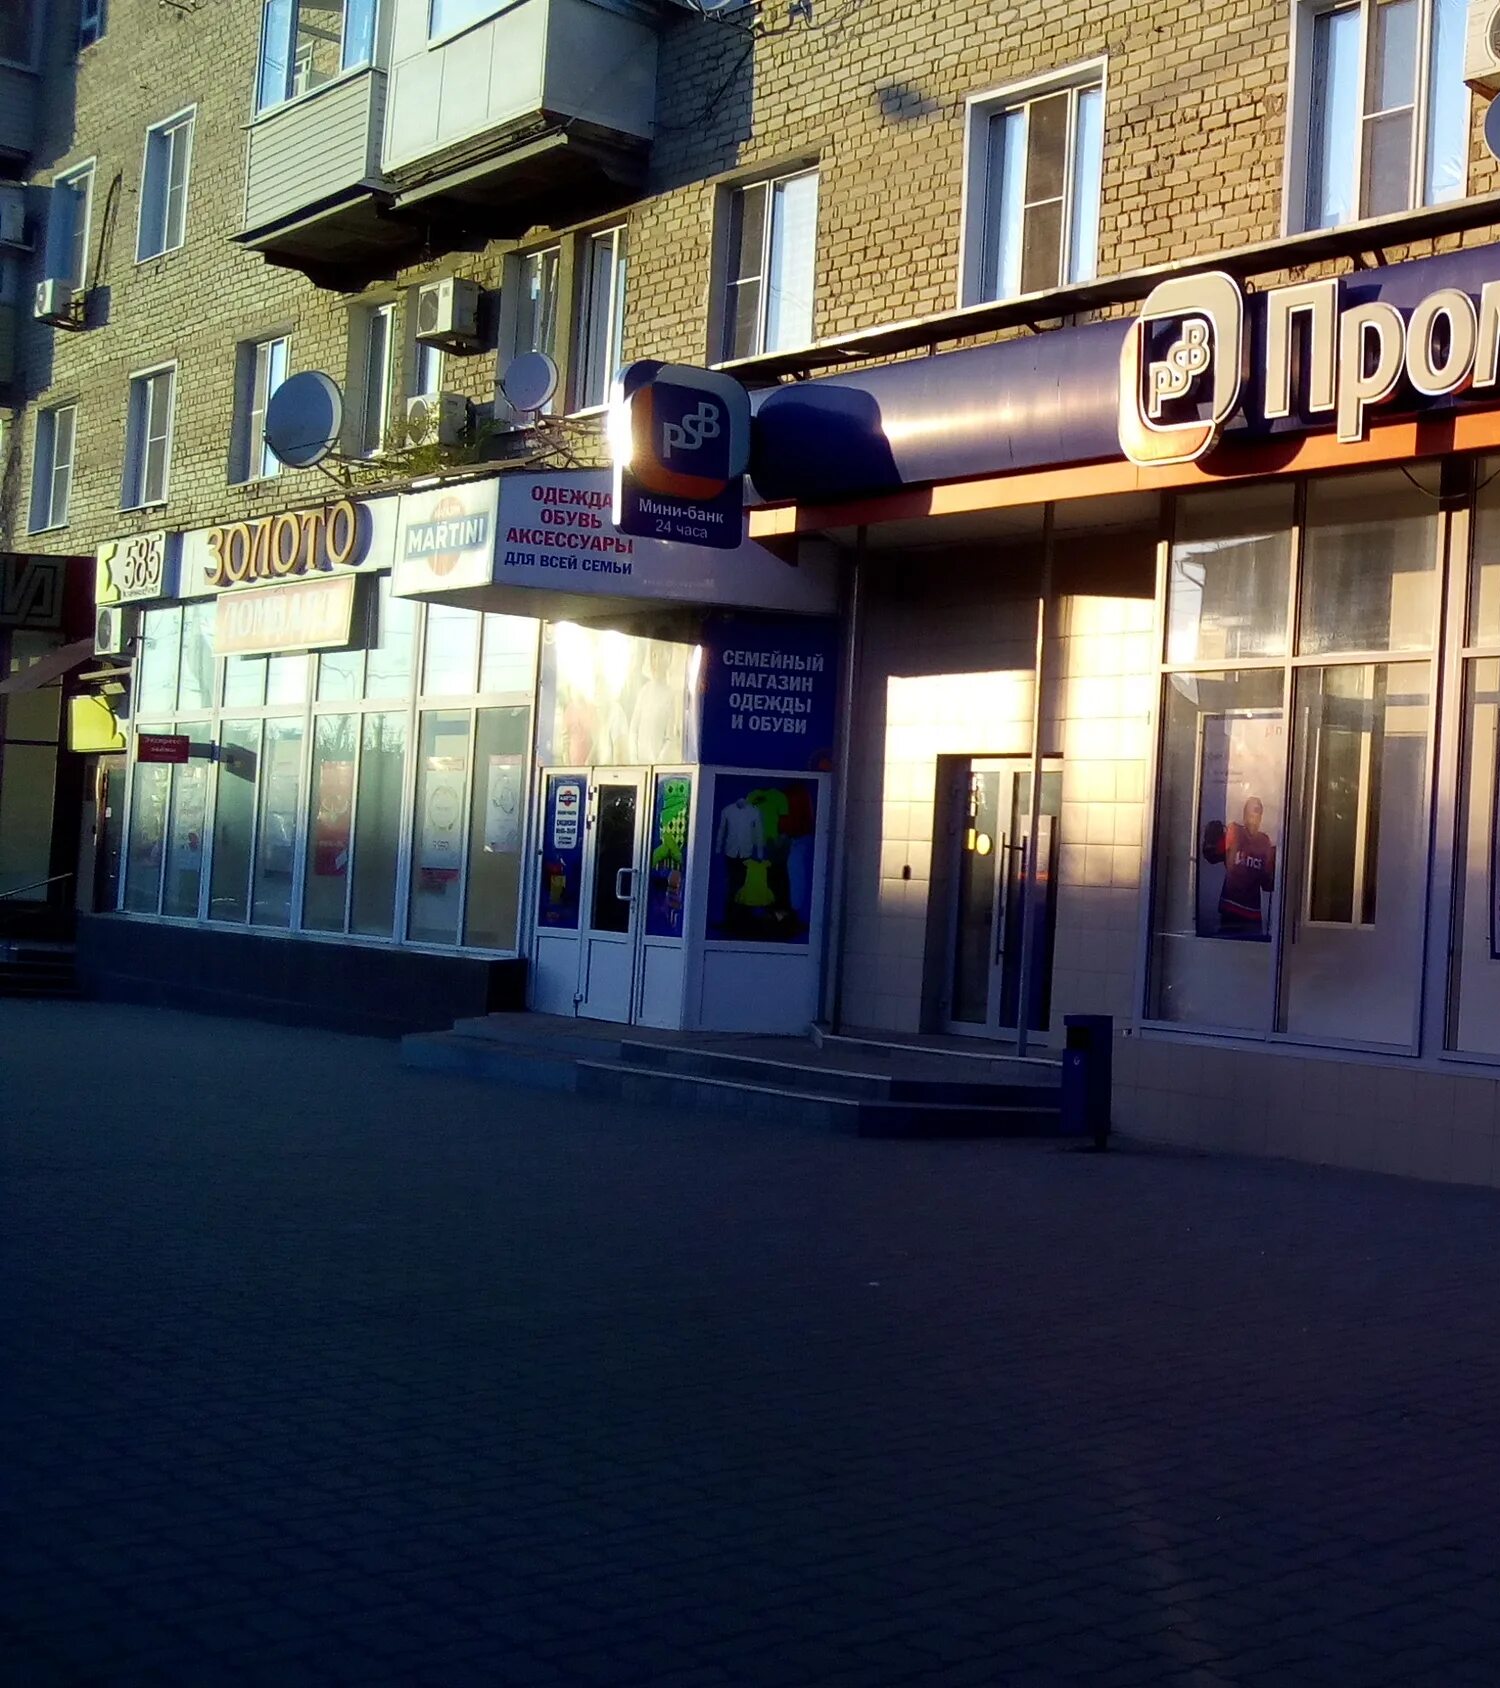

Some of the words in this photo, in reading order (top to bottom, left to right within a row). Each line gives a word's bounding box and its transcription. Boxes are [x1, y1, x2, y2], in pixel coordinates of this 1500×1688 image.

[531, 485, 613, 509] ОДЕЖДА
[540, 508, 603, 530] ОБУВЬ
[639, 498, 724, 524] Мини-банк
[408, 517, 484, 553] MARTINI
[506, 527, 634, 554] АКСЕССУАРЫ
[655, 519, 672, 534] 24
[676, 523, 708, 539] часа
[204, 500, 360, 586] ЗОЛОТО
[123, 536, 161, 589] 585
[504, 551, 535, 566] ДЛЯ
[540, 554, 578, 571] ВСЕЙ
[582, 559, 633, 576] СЕМЬИ
[723, 649, 824, 672] СЕМЕЙНЫЙ
[731, 671, 813, 692] МАГАЗИН
[729, 693, 812, 715] ОДЕЖДЫ
[731, 714, 744, 730] И
[748, 715, 807, 735] ОБУВИ
